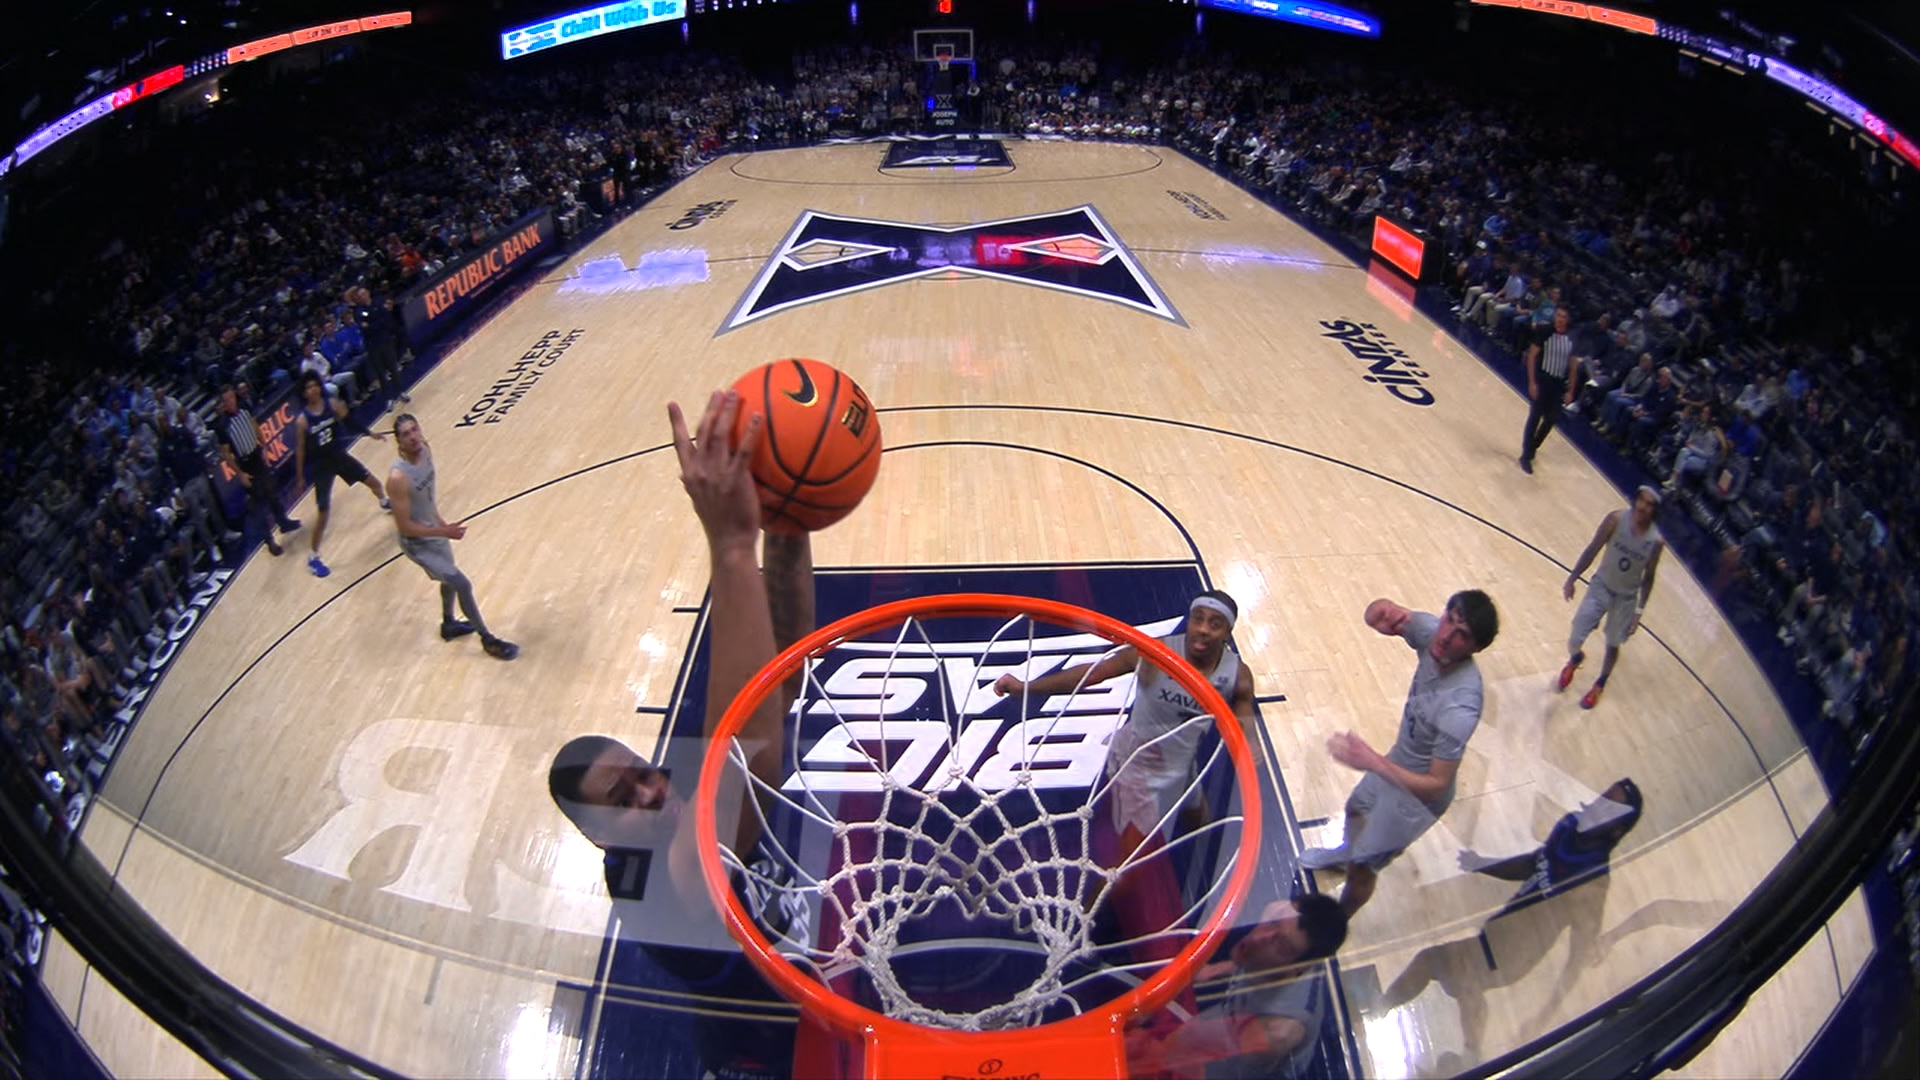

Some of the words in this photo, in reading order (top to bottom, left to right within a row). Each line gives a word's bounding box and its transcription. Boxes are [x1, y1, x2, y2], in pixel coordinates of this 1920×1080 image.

[561, 14, 601, 38] Chill
[604, 4, 649, 27] With
[652, 1, 677, 17] Us
[423, 247, 502, 320] REPUBLIC
[502, 222, 542, 265] BANK
[453, 329, 562, 429] KOHLHEPP
[483, 370, 545, 425] FAMILY
[537, 328, 586, 368] COURT
[1618, 556, 1631, 573] 0
[780, 714, 1131, 792] BIG
